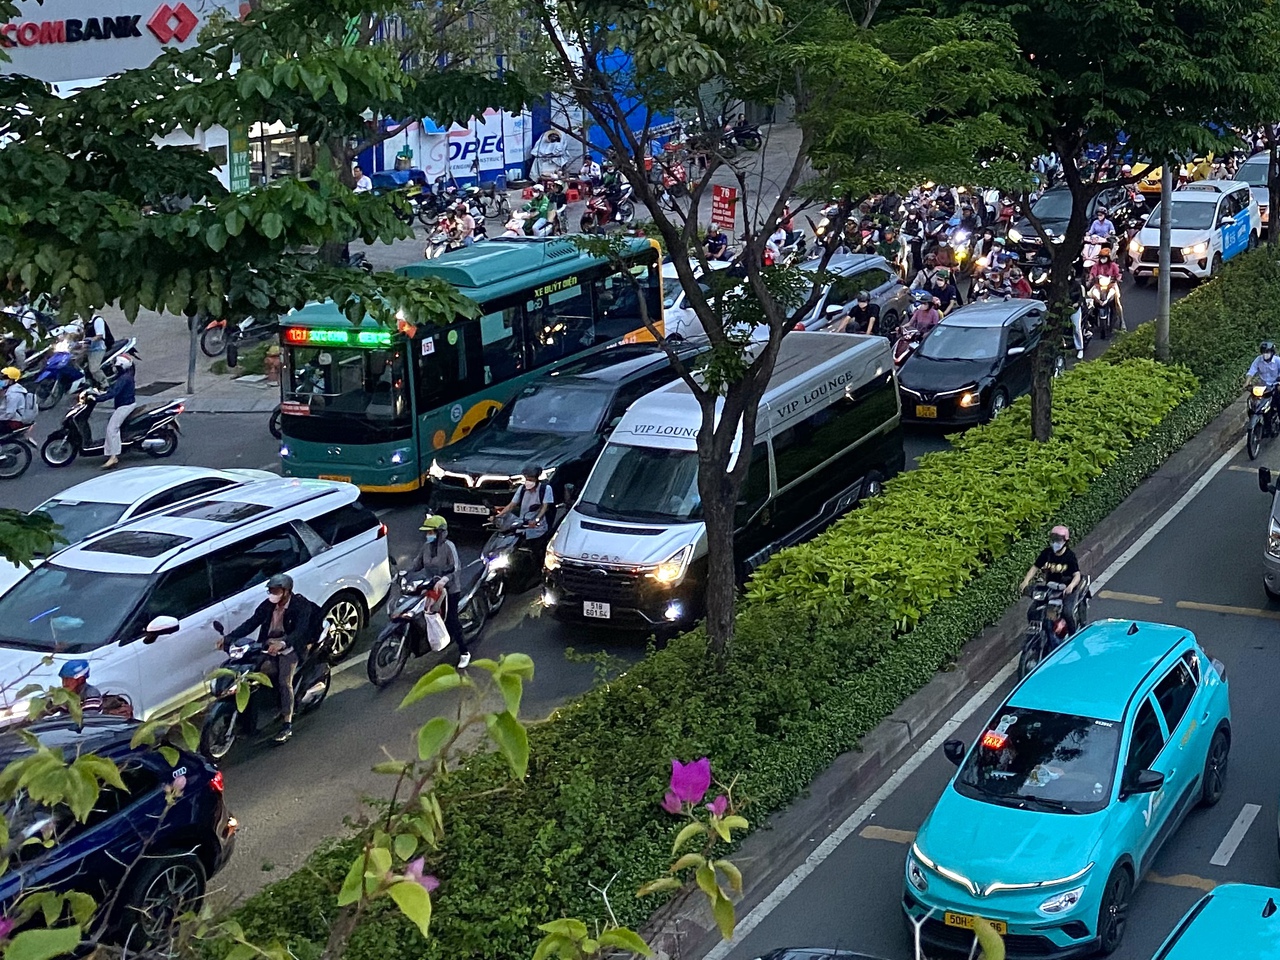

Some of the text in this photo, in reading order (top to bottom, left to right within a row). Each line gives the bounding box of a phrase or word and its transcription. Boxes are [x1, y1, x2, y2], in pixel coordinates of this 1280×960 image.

[1, 14, 143, 49] COMBANK
[720, 187, 731, 198] 76
[771, 370, 854, 418] VIP LOUNGE
[634, 424, 655, 434] VIP
